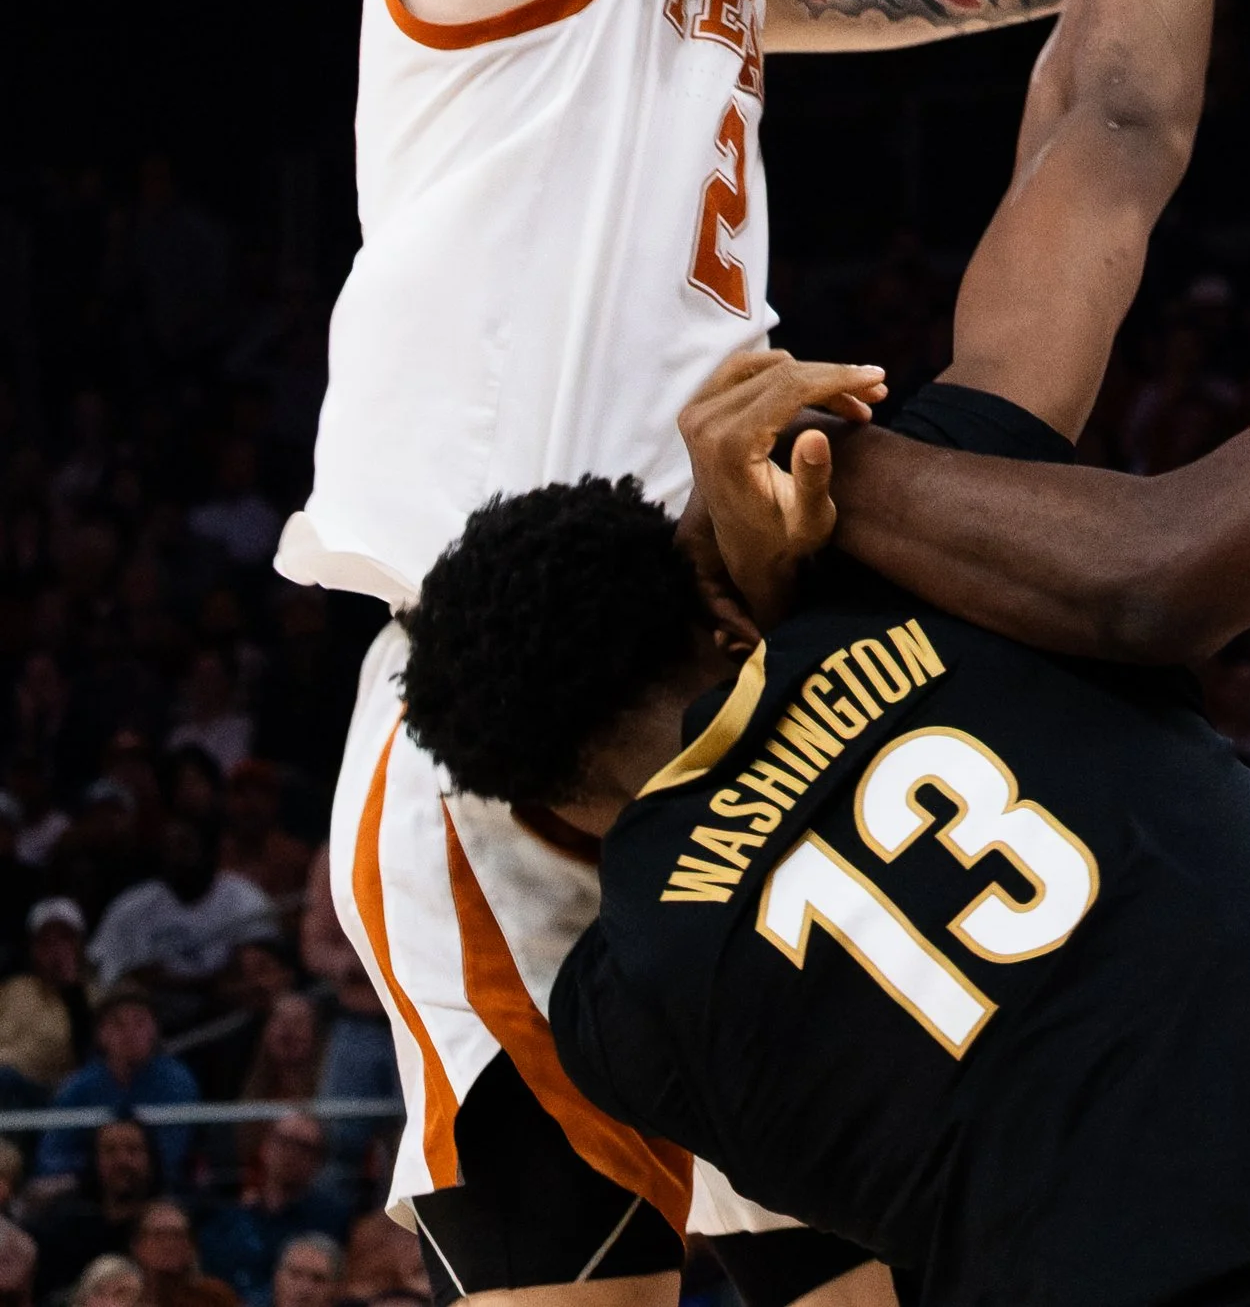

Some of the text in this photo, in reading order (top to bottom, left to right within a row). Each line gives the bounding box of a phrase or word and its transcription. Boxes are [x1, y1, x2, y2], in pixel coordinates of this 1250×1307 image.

[687, 96, 752, 320] 2
[659, 618, 947, 904] WASHINGTON
[755, 725, 1101, 1061] 13
